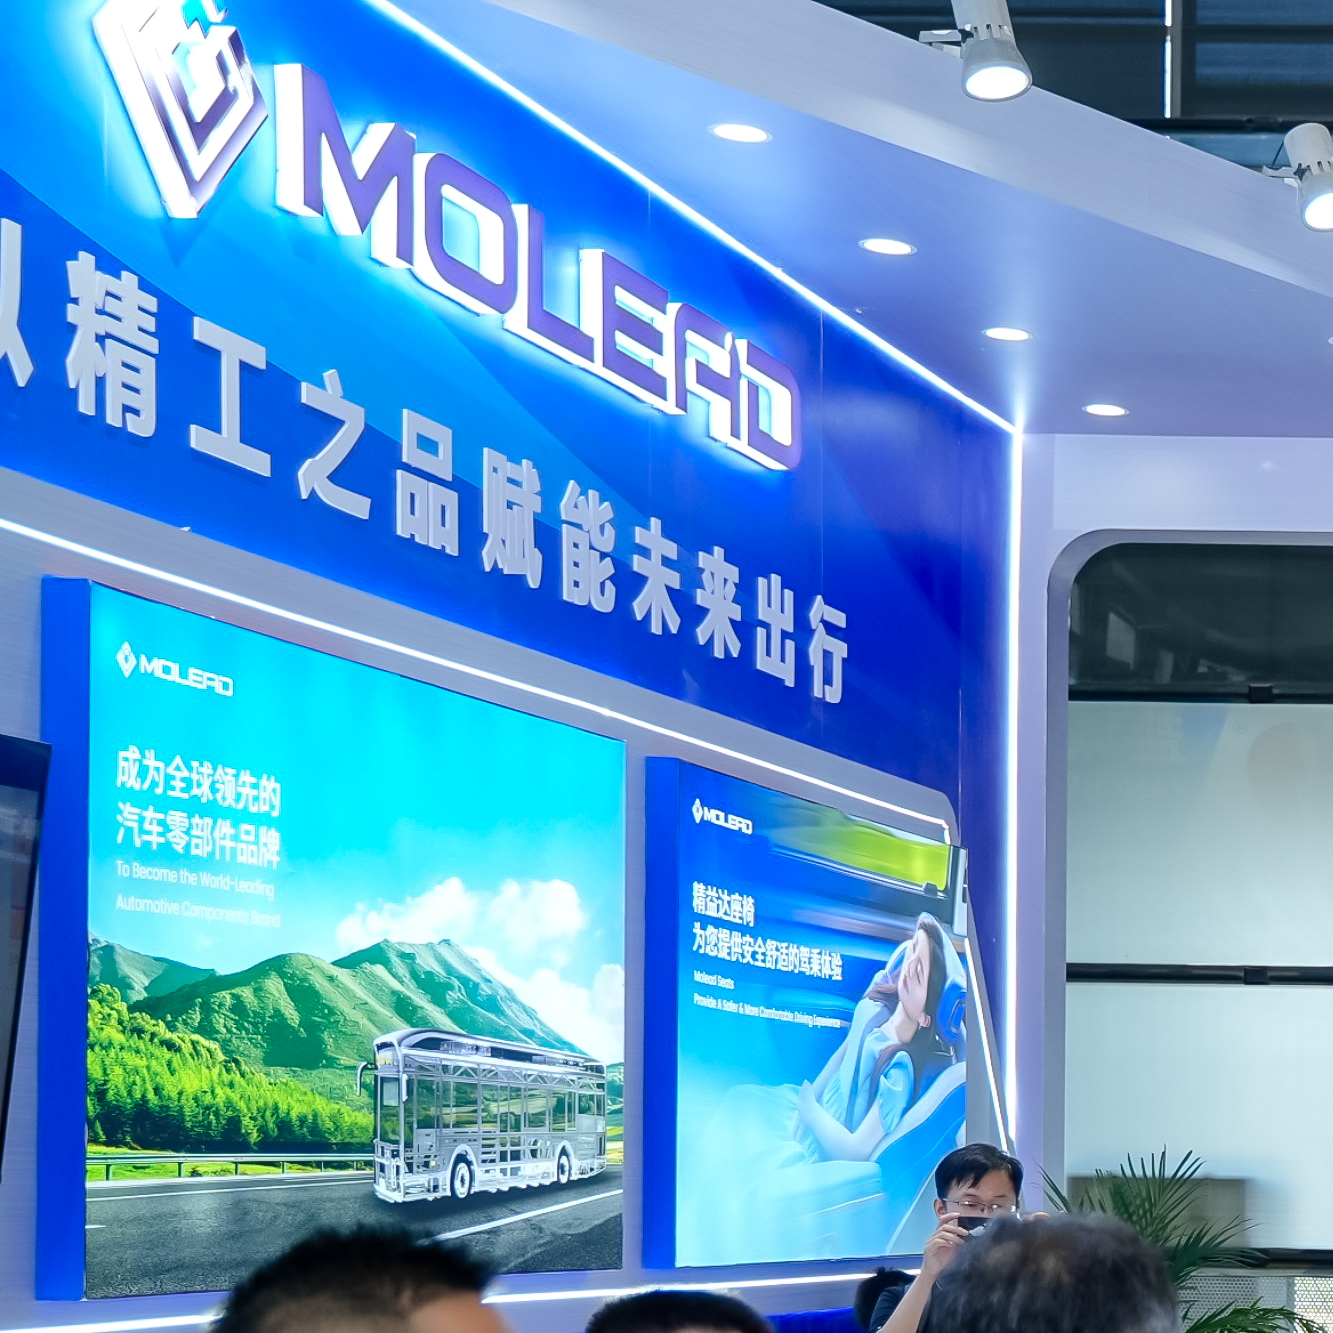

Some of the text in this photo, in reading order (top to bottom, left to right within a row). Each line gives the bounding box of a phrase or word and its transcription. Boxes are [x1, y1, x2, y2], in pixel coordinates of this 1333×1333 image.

[274, 63, 802, 471] MOLEAD
[140, 653, 234, 697] MOLEAD
[116, 745, 282, 817] 成为全球领先的
[116, 801, 282, 869] 汽车零部件品牌
[704, 807, 753, 834] MOLEAD
[116, 860, 130, 877] To
[133, 862, 178, 883] Become
[180, 868, 198, 885] the
[692, 881, 755, 927] 精益达座椅
